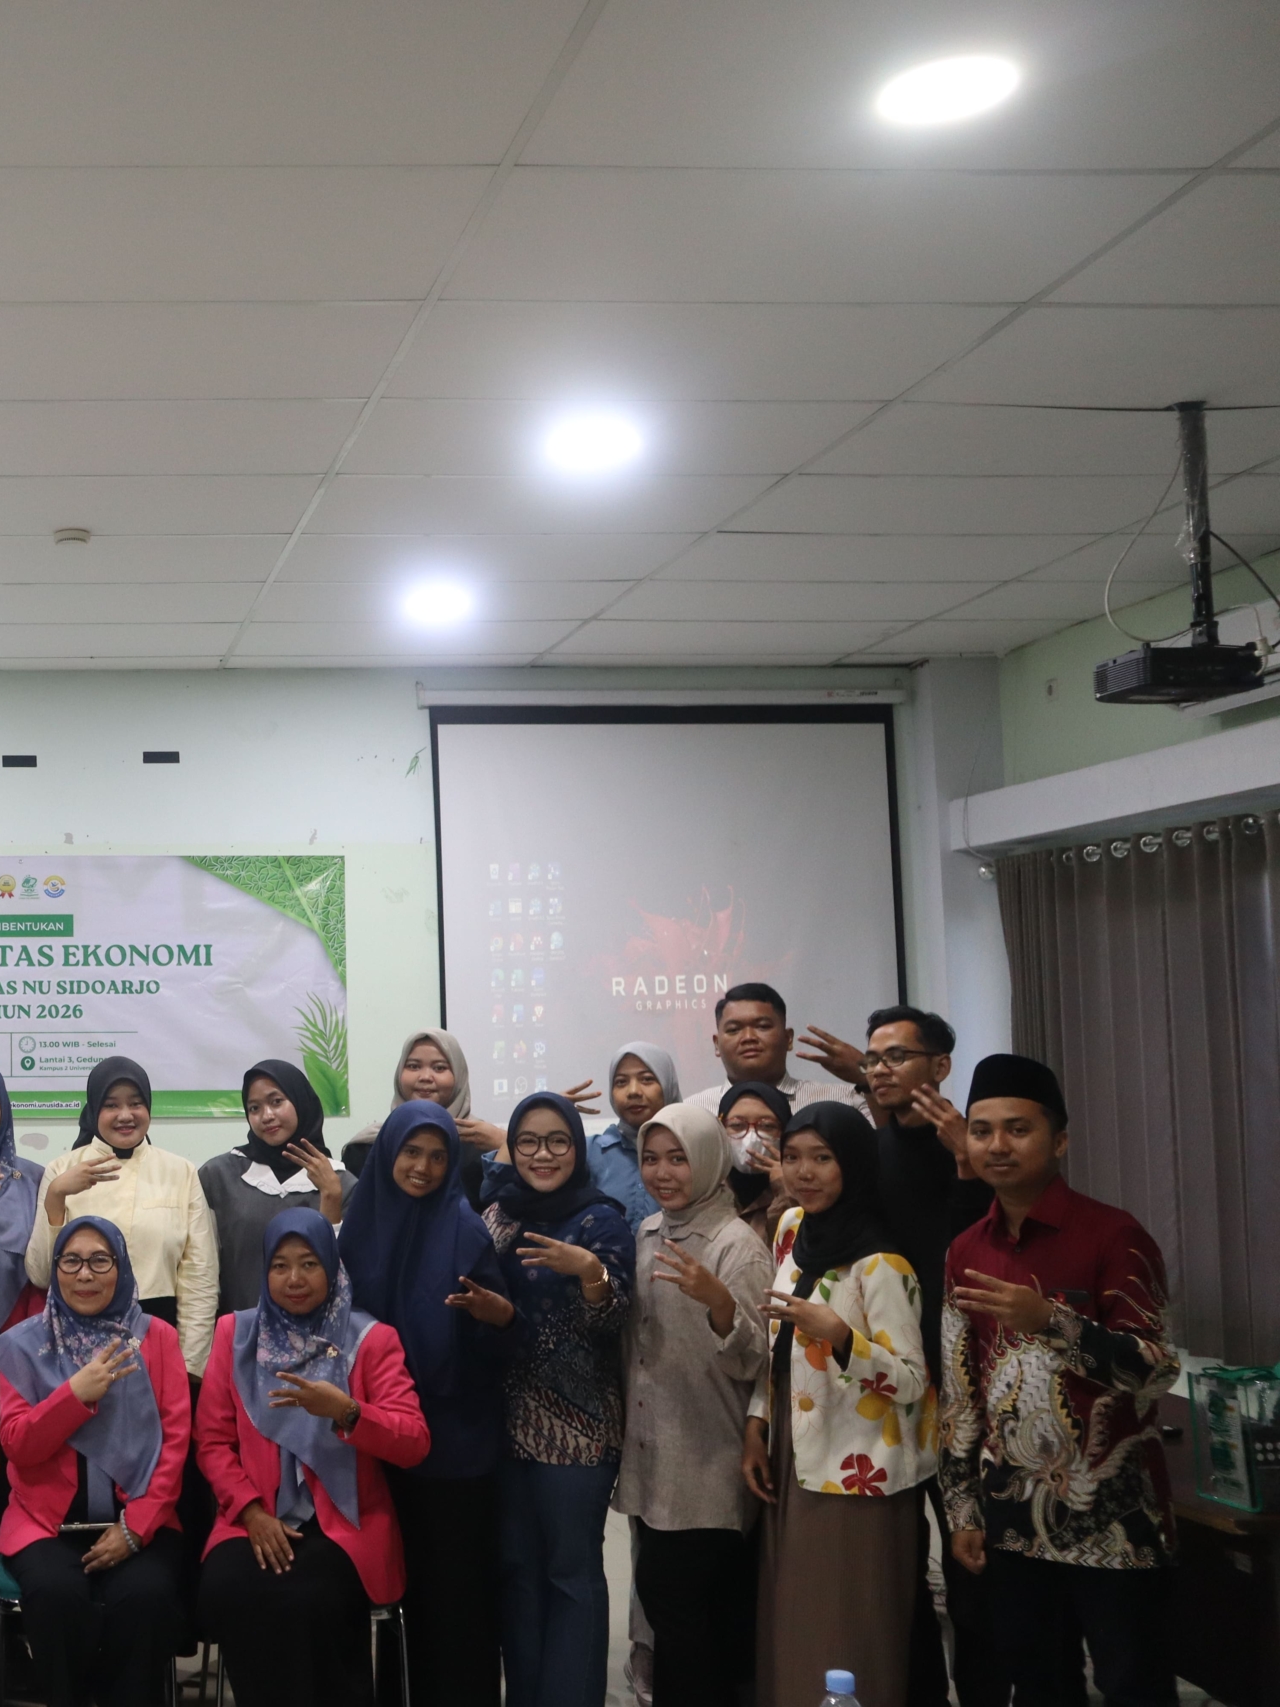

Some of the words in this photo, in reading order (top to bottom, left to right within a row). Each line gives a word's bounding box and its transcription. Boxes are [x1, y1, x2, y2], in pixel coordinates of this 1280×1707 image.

[61, 944, 213, 967] EKONOMI
[22, 980, 52, 995] NU
[56, 979, 161, 995] SIDOARJO
[612, 974, 728, 996] RADEON
[36, 1003, 84, 1019] 2026
[636, 999, 707, 1011] GRAPHICS
[87, 1040, 116, 1048] Selesai
[67, 1056, 75, 1064] 3,
